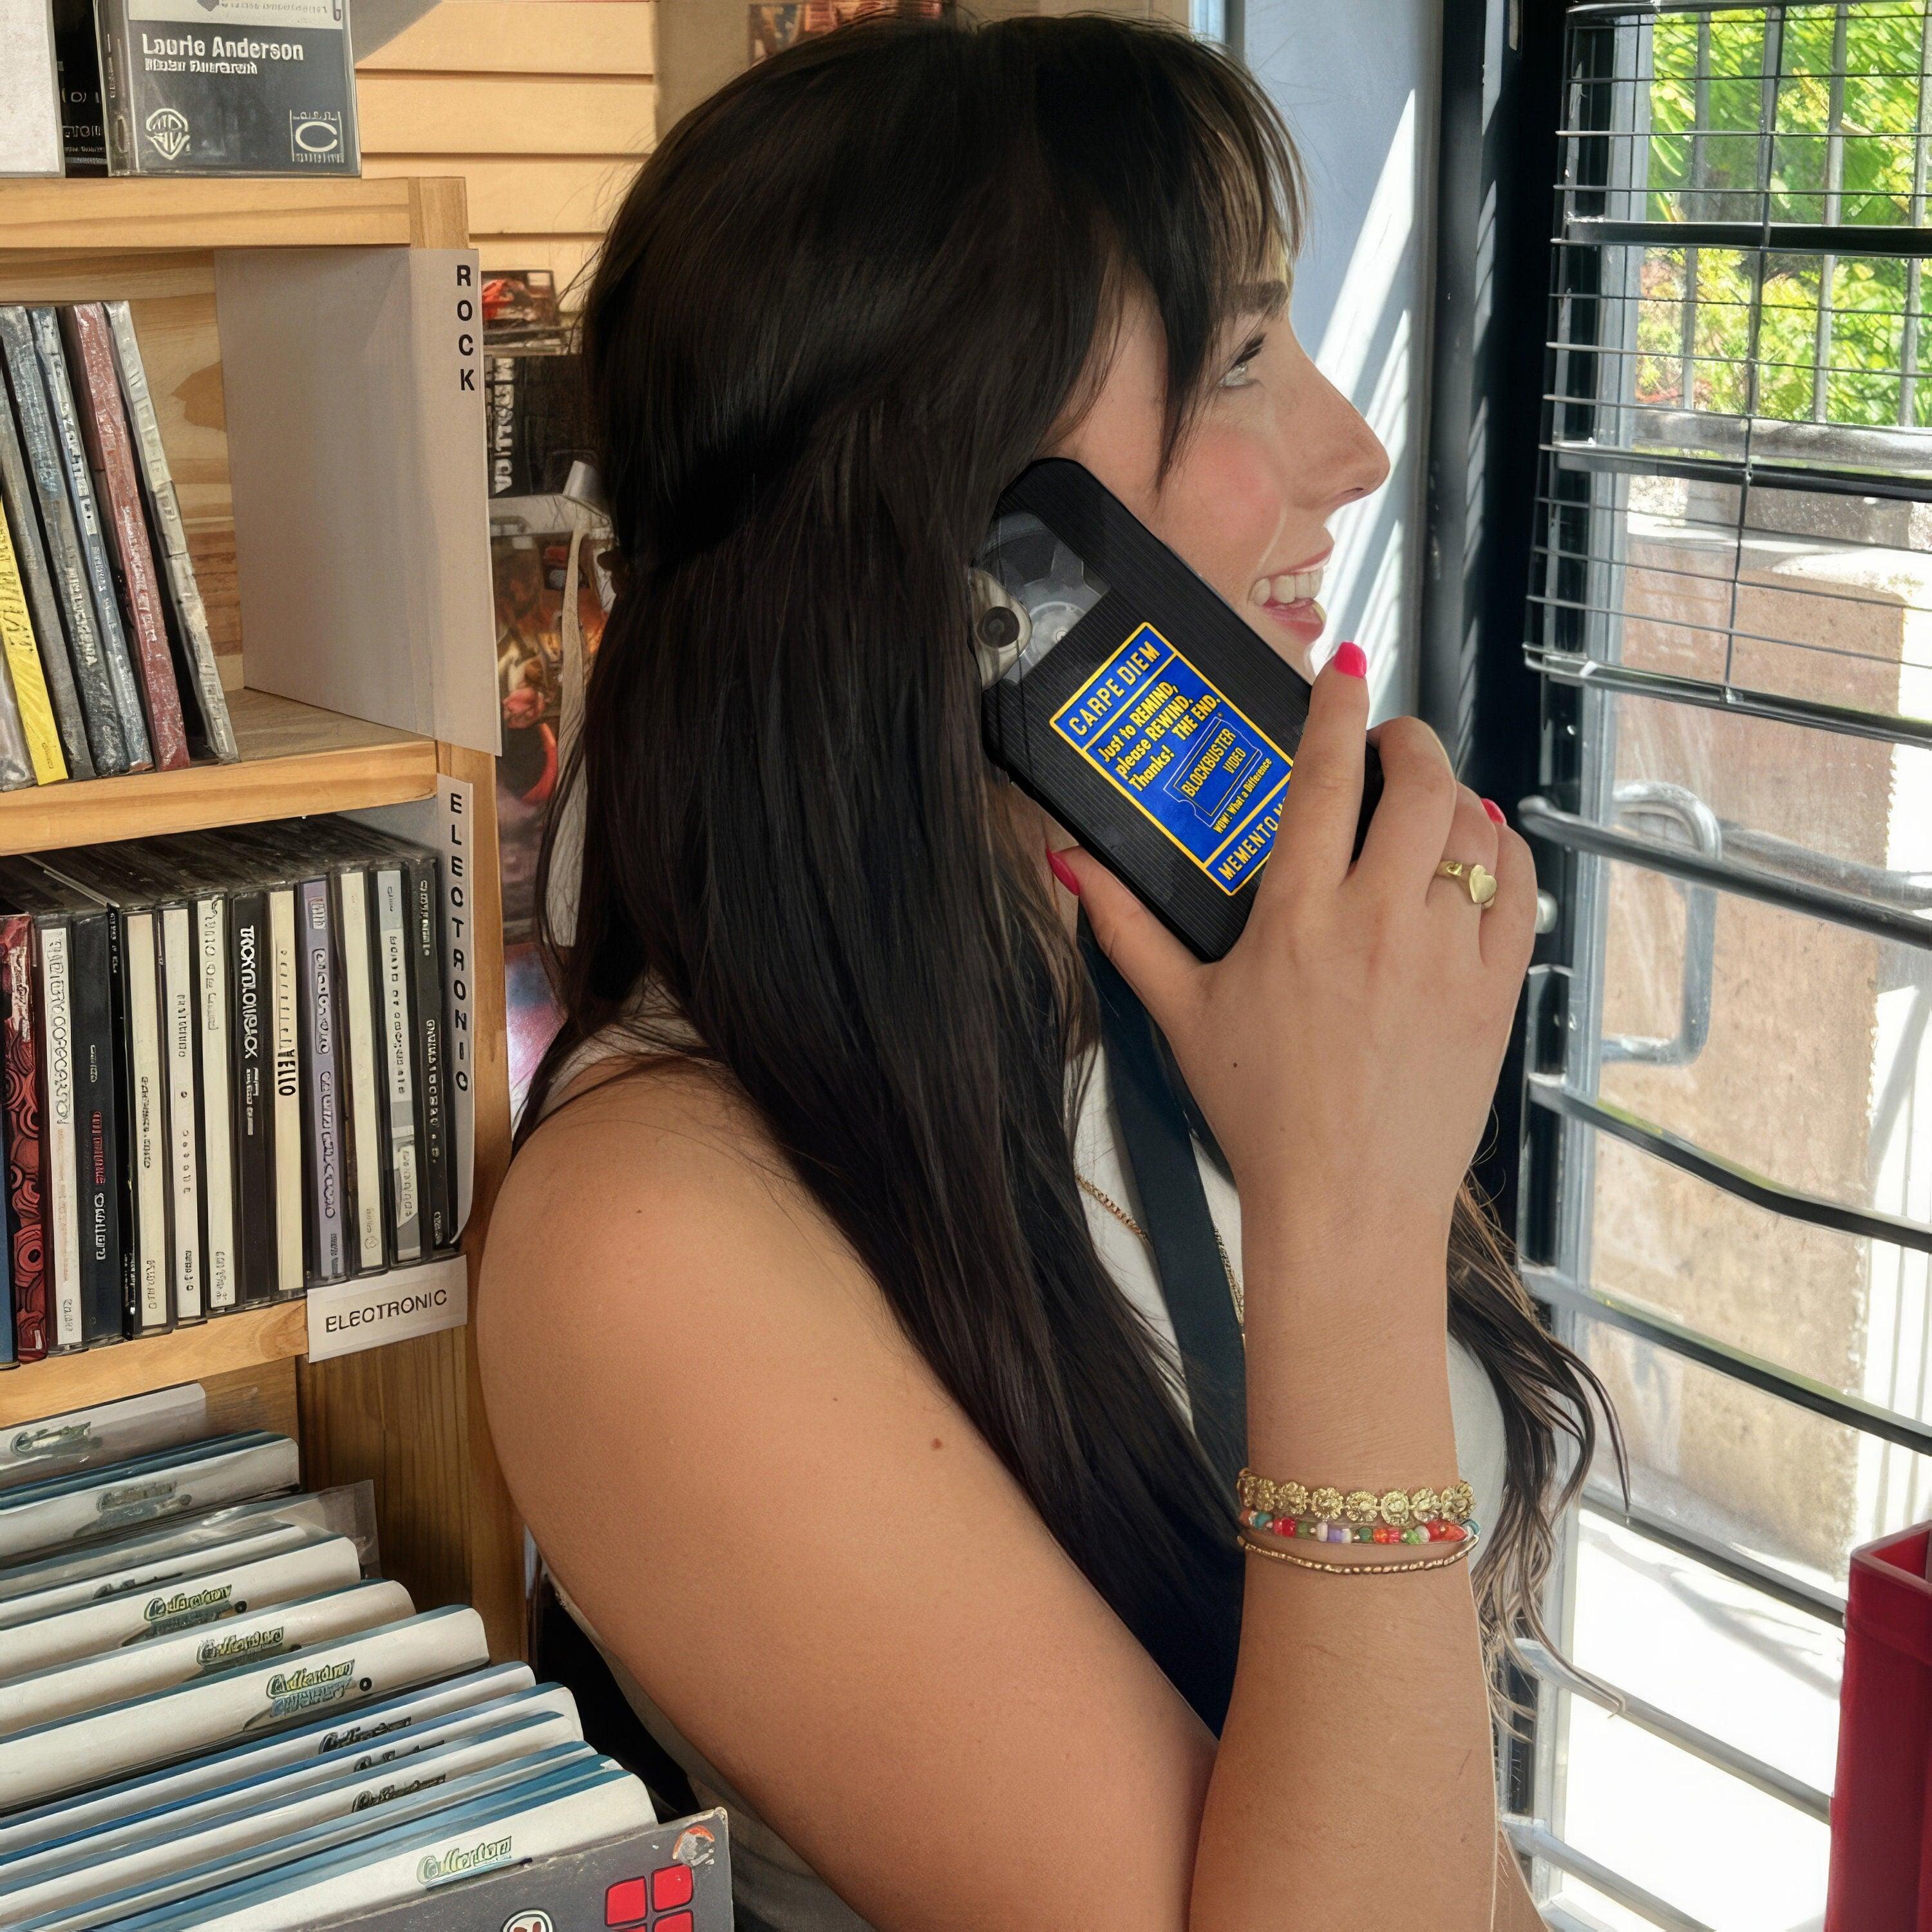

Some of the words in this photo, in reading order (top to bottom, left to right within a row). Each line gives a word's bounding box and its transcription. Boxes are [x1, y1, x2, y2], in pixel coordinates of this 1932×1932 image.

[212, 36, 304, 61] Anderson
[456, 265, 475, 392] ROCK
[1068, 678, 1125, 735] CARPE
[1116, 640, 1160, 686] DIEM
[1097, 734, 1125, 762] Just
[1119, 724, 1136, 740] to
[1129, 681, 1179, 727] REMIND,
[1115, 739, 1151, 780] please
[1144, 695, 1193, 741] REWIND.
[1128, 744, 1175, 791] Thanks!
[1171, 714, 1198, 741] THE
[1190, 694, 1221, 721] END.
[1181, 728, 1236, 797] BLOCKBUSTER
[1222, 747, 1247, 774] VIDEO
[1213, 812, 1233, 834] WOW!
[1227, 795, 1245, 815] What
[1242, 758, 1273, 793] Difference
[1217, 816, 1279, 881] MEMENTO
[326, 1289, 448, 1333] ELECTRONIC
